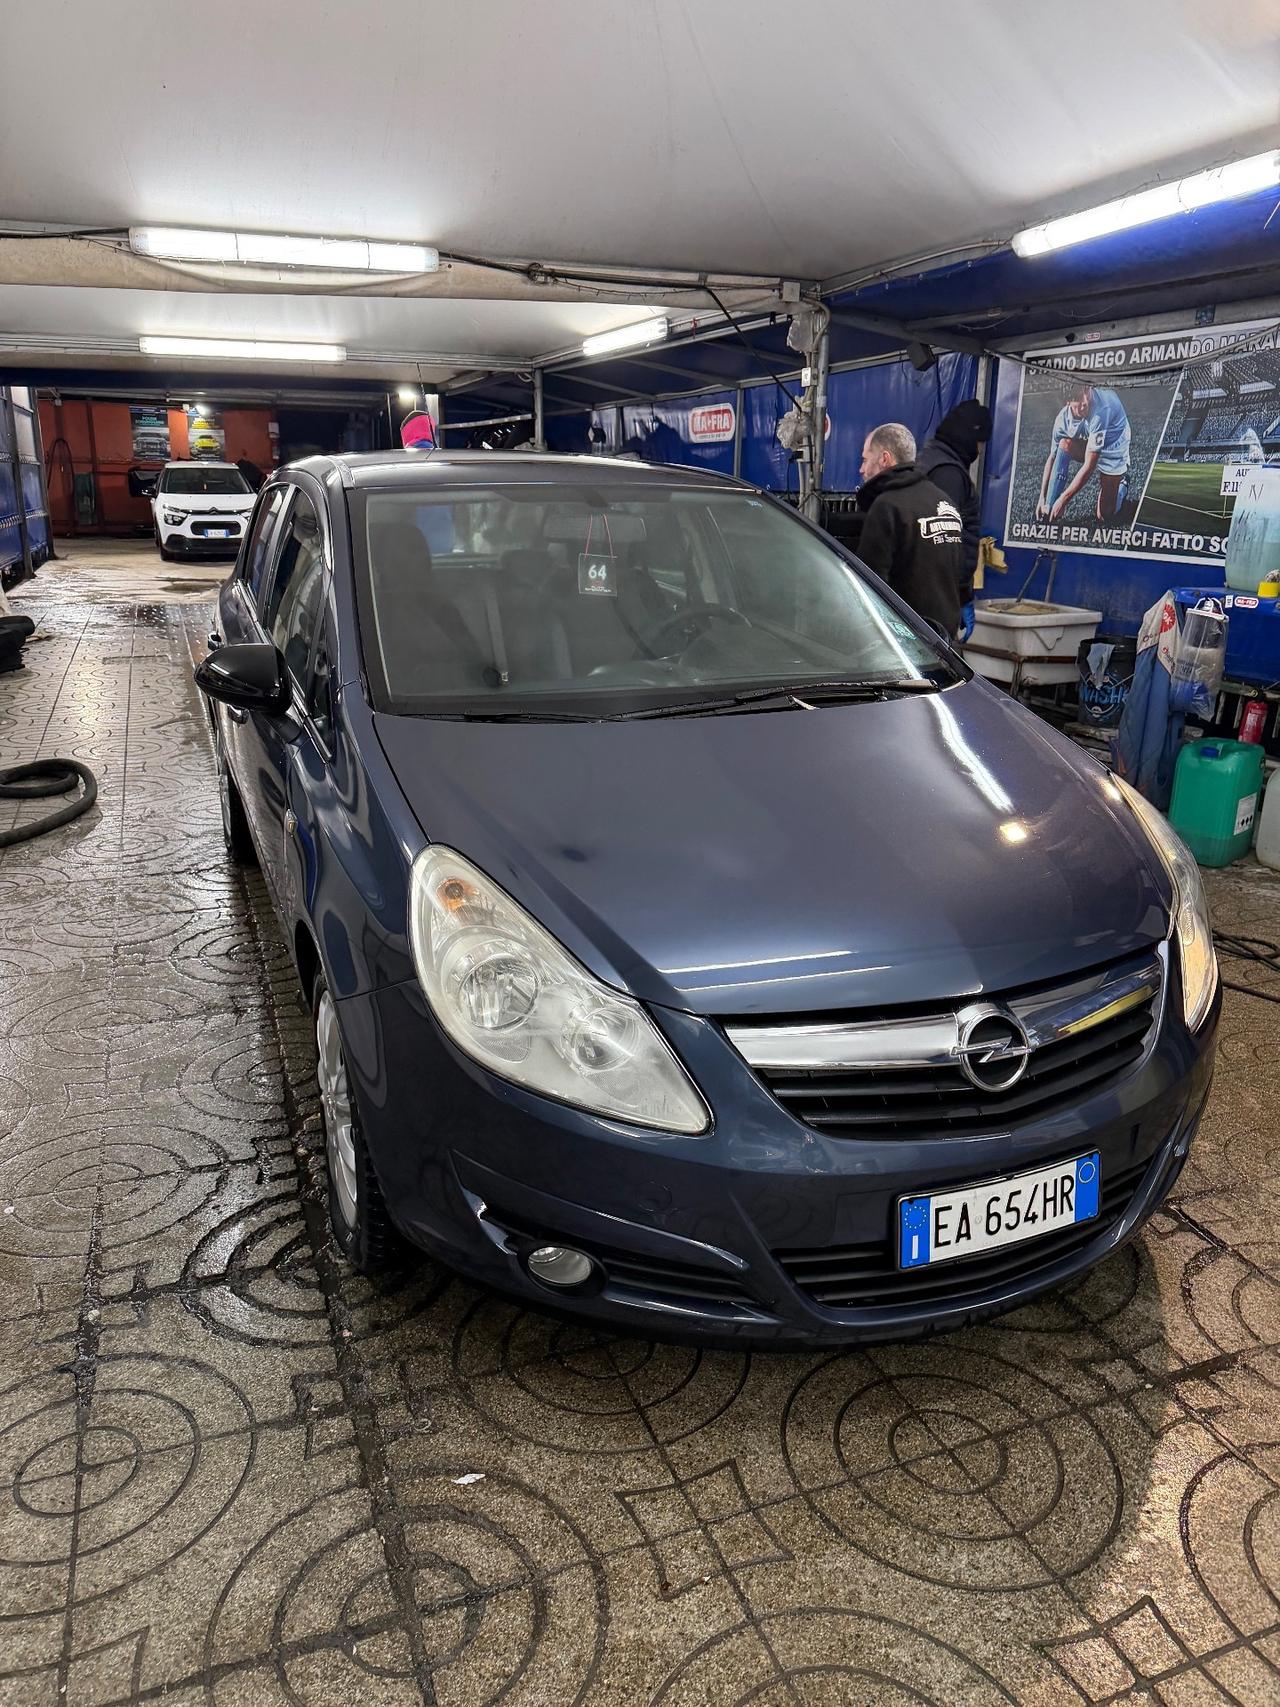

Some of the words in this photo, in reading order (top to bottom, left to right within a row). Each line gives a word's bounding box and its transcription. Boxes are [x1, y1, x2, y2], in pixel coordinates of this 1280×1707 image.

[1080, 348, 1126, 370] DIEGO
[1130, 339, 1215, 364] ARMANDO
[1012, 523, 1058, 540] GRAZIE
[1062, 528, 1088, 543] PER
[1092, 529, 1147, 547] AVERCI
[1151, 533, 1204, 552] FATTO
[588, 564, 607, 581] 64
[934, 1201, 972, 1248] EA
[985, 1174, 1075, 1236] 654HR
